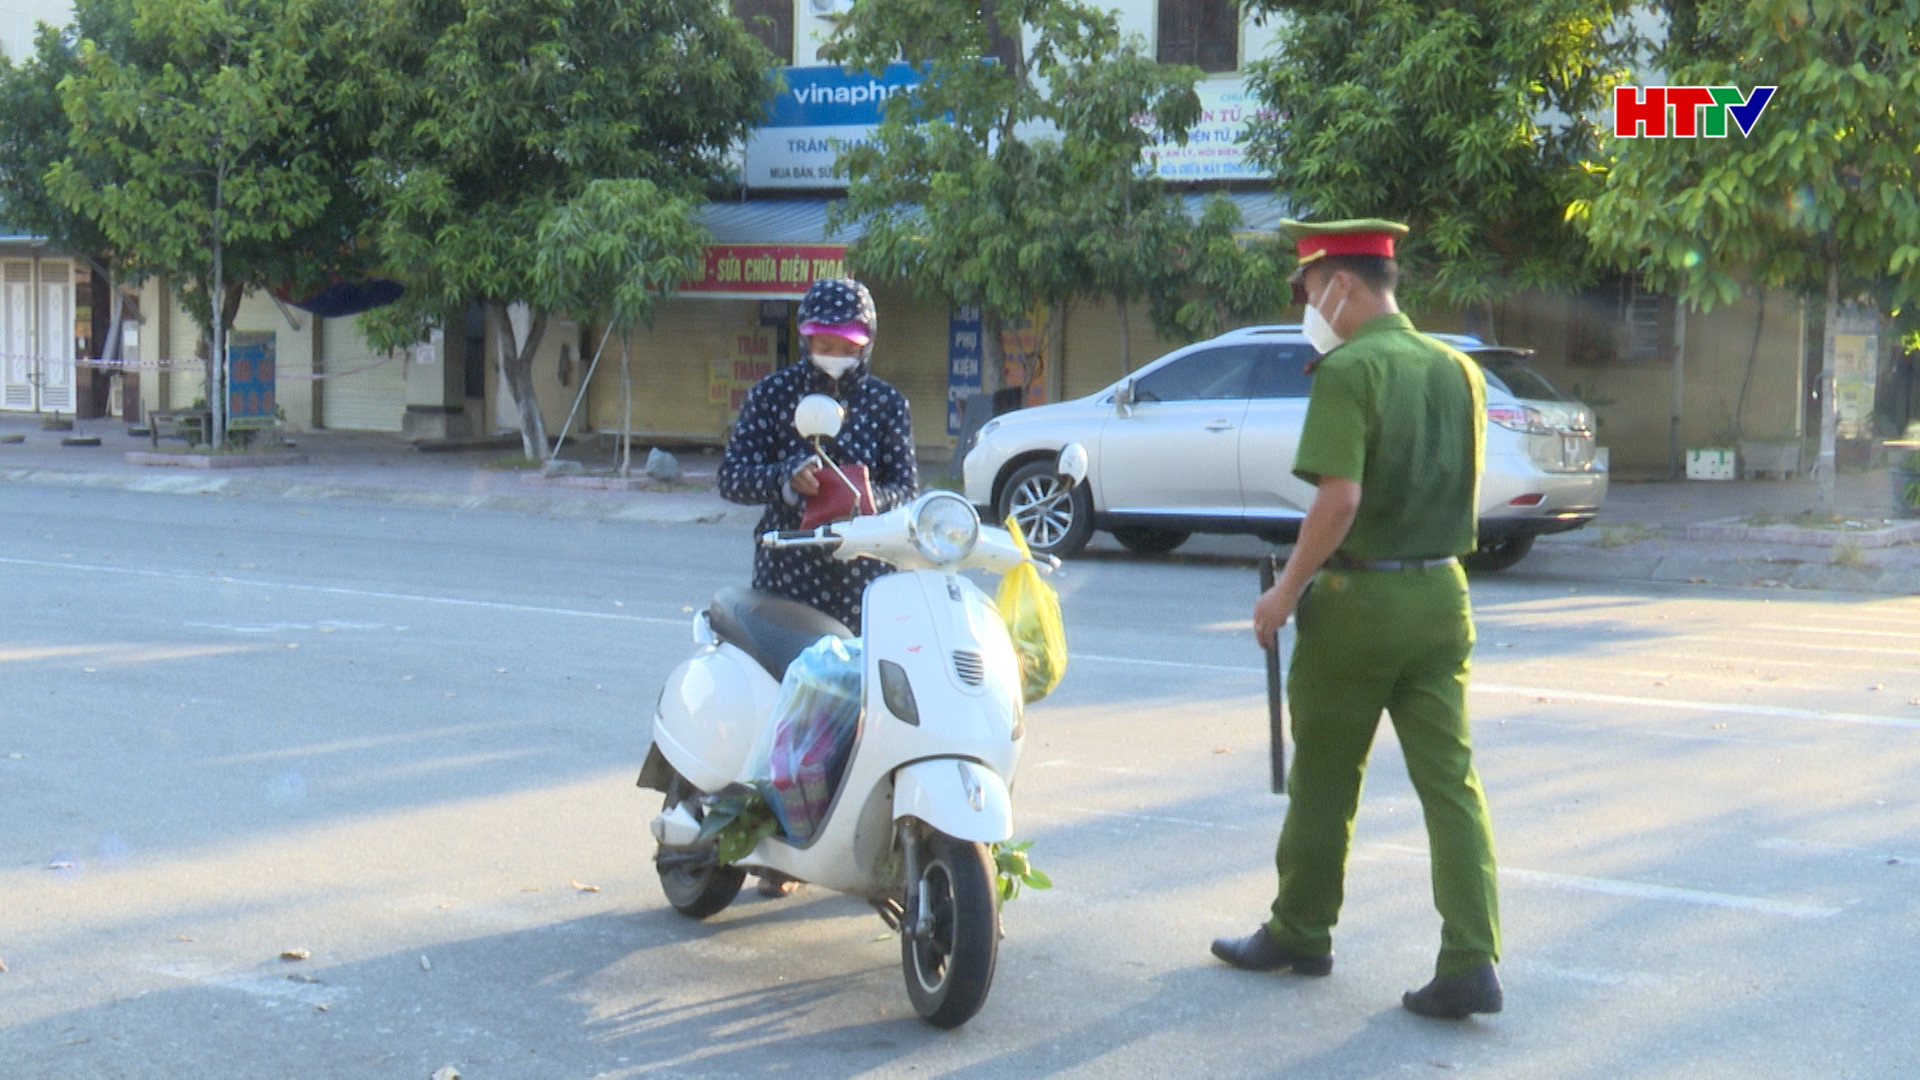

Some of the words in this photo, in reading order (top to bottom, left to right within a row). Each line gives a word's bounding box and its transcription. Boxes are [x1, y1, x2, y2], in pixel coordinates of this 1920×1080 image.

[793, 79, 926, 106] vinaph
[744, 253, 777, 282] CHỮA
[780, 254, 809, 288] ĐIỆN
